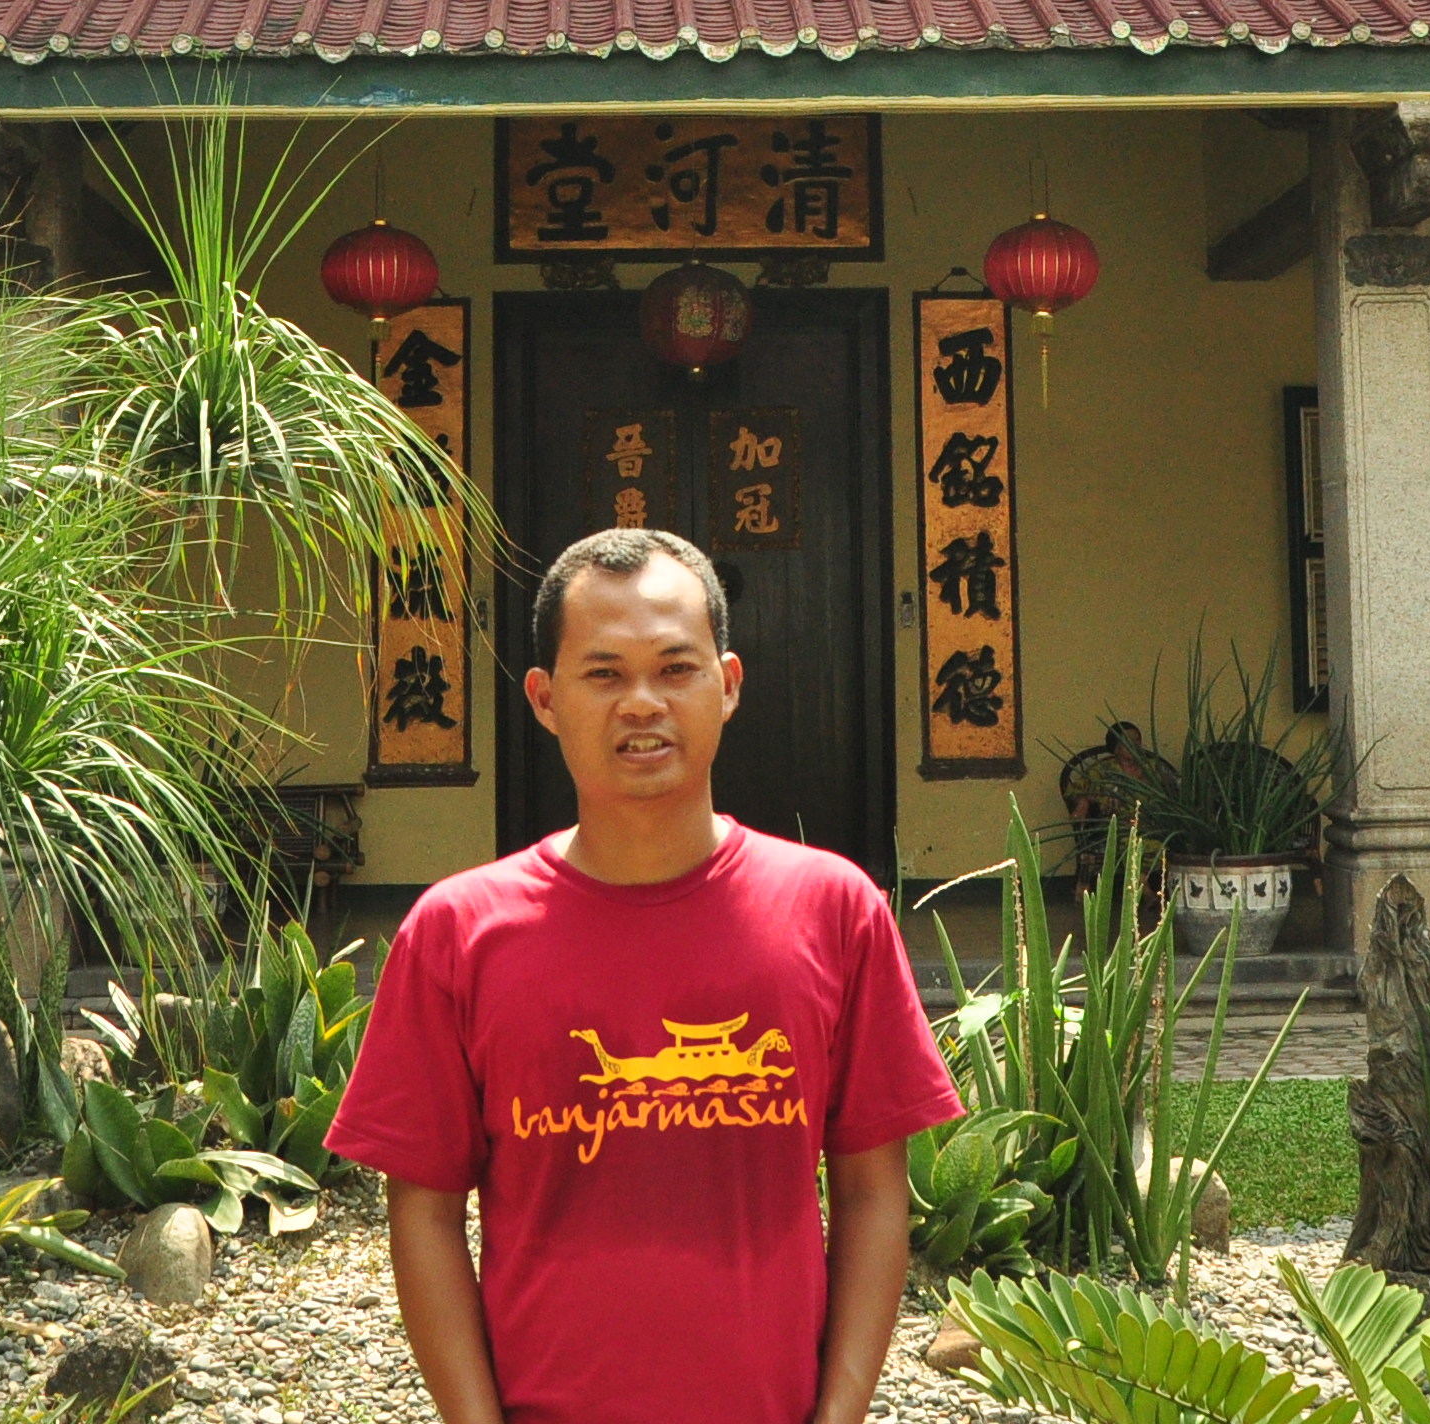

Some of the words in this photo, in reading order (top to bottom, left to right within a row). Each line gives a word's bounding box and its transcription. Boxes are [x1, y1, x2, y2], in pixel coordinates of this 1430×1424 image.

[526, 119, 854, 242] 清河堂
[728, 424, 784, 535] 加冠
[929, 327, 1007, 728] 西銘積德
[512, 1082, 809, 1164] banjarmasin
